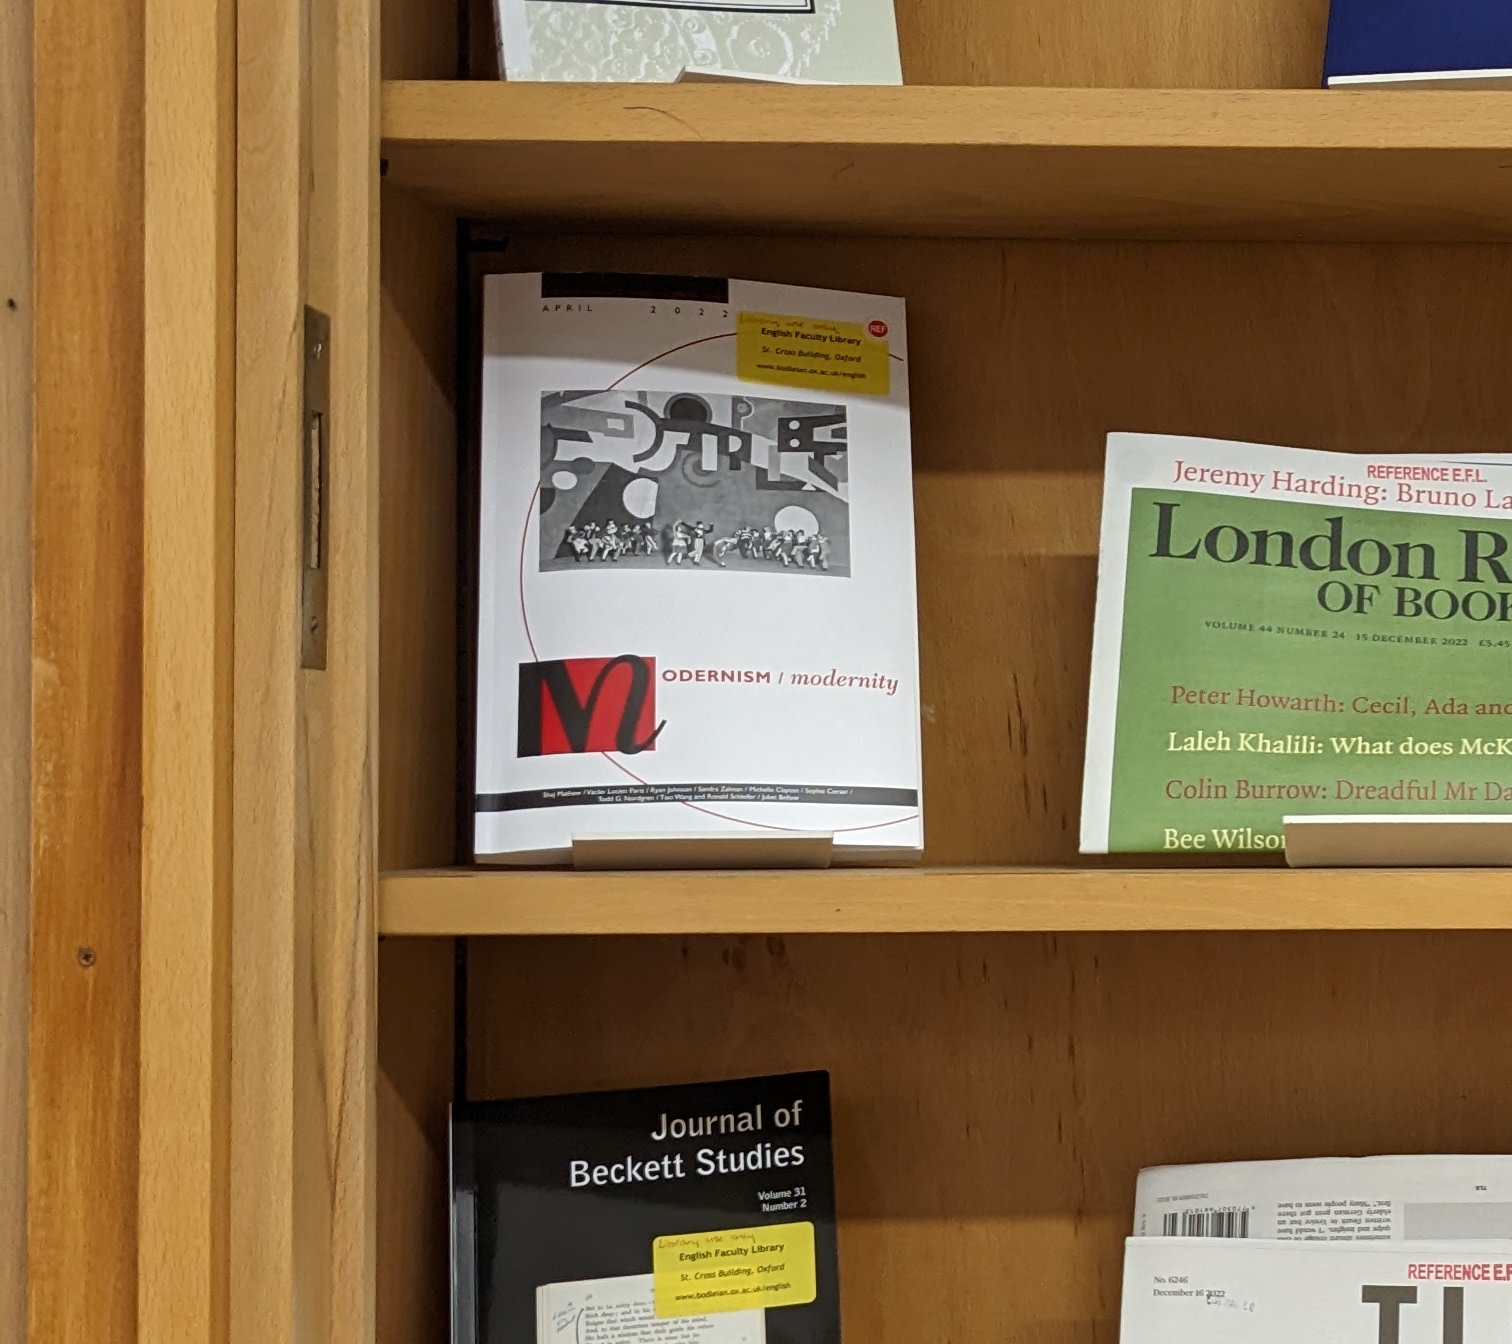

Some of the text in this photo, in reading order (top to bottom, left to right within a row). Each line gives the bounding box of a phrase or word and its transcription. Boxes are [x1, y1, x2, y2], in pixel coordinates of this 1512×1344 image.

[1173, 460, 1265, 493] Jeremy
[1272, 469, 1388, 504] Harding:
[1396, 481, 1476, 507] Bruno
[1367, 465, 1488, 483] REFERENCE E.F.L.
[1148, 502, 1440, 581] London
[1317, 581, 1381, 614] OF
[662, 669, 770, 684] ODERNISM
[790, 669, 898, 695] modernity
[1170, 685, 1231, 707] Peter
[1236, 688, 1346, 713] Howarth:
[1351, 696, 1416, 719] Cecil,
[1424, 696, 1469, 715] Ada
[1168, 732, 1232, 753] Laleh
[1237, 732, 1325, 756] Khalili:
[1330, 736, 1394, 757] What
[1399, 737, 1454, 756] does
[1166, 779, 1229, 800] Colin
[1235, 780, 1328, 800] Burrow:
[1335, 780, 1437, 802] Dreadful
[1444, 781, 1477, 802] Mr
[1163, 828, 1206, 850] Bee
[650, 1100, 803, 1140] Journal of
[570, 1141, 805, 1187] Beckett Studies
[758, 1186, 806, 1203] Volume 31
[762, 1198, 807, 1212] Number 2
[679, 1242, 784, 1263] English Faculty Library
[1408, 1263, 1491, 1280] REFERENCE
